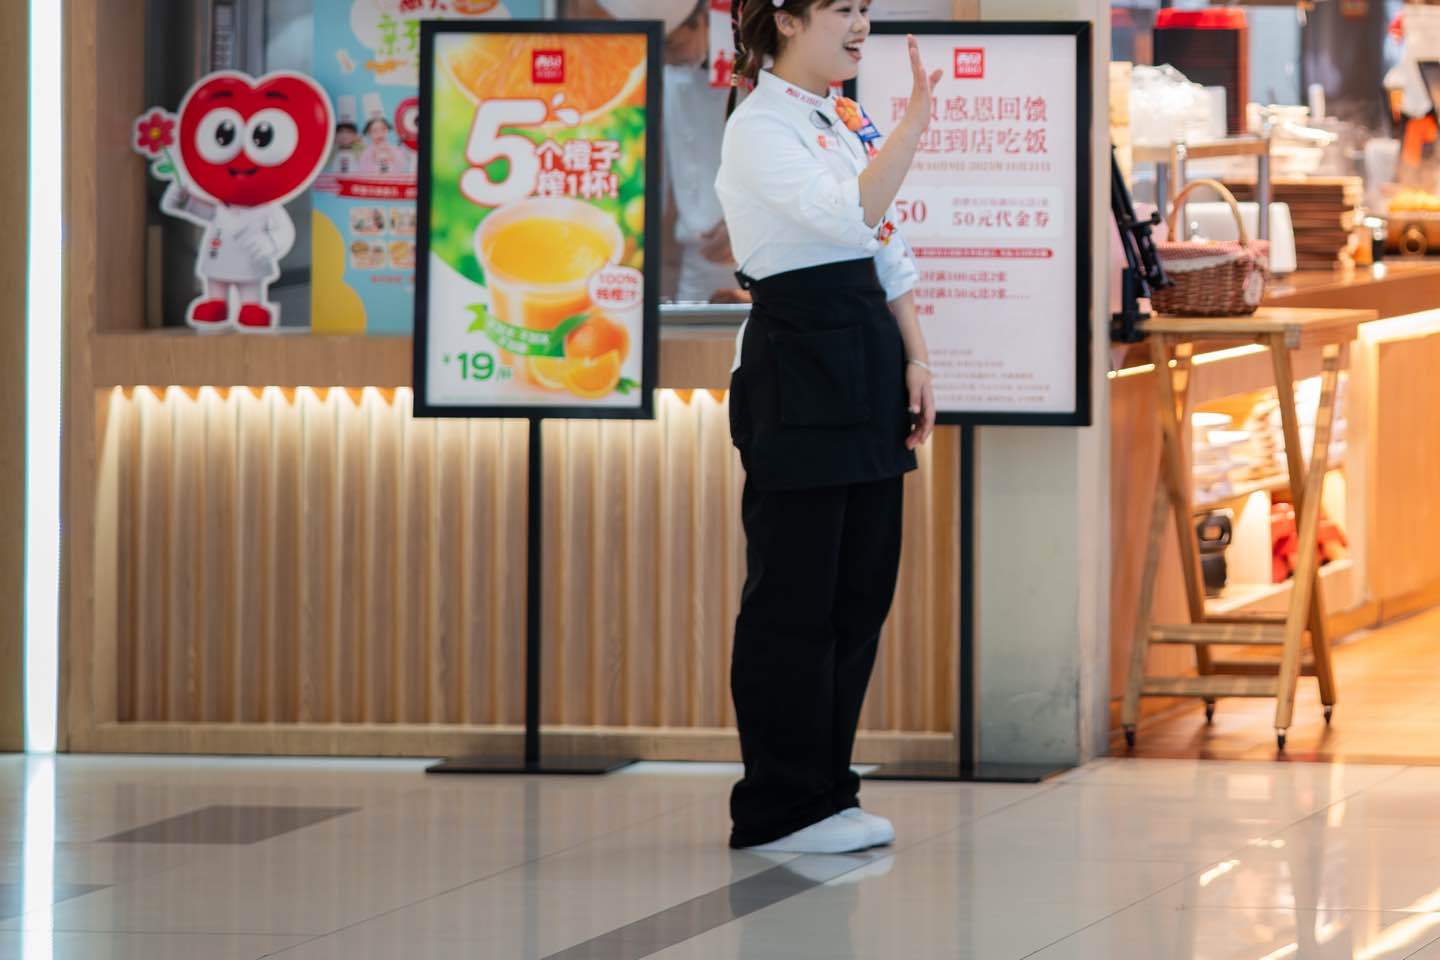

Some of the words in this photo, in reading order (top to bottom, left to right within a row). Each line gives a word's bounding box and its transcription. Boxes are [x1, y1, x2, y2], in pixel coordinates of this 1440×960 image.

[460, 98, 548, 208] 5
[536, 139, 621, 173] 个橙子
[896, 199, 928, 224] 50
[952, 211, 1050, 228] 50元代金券
